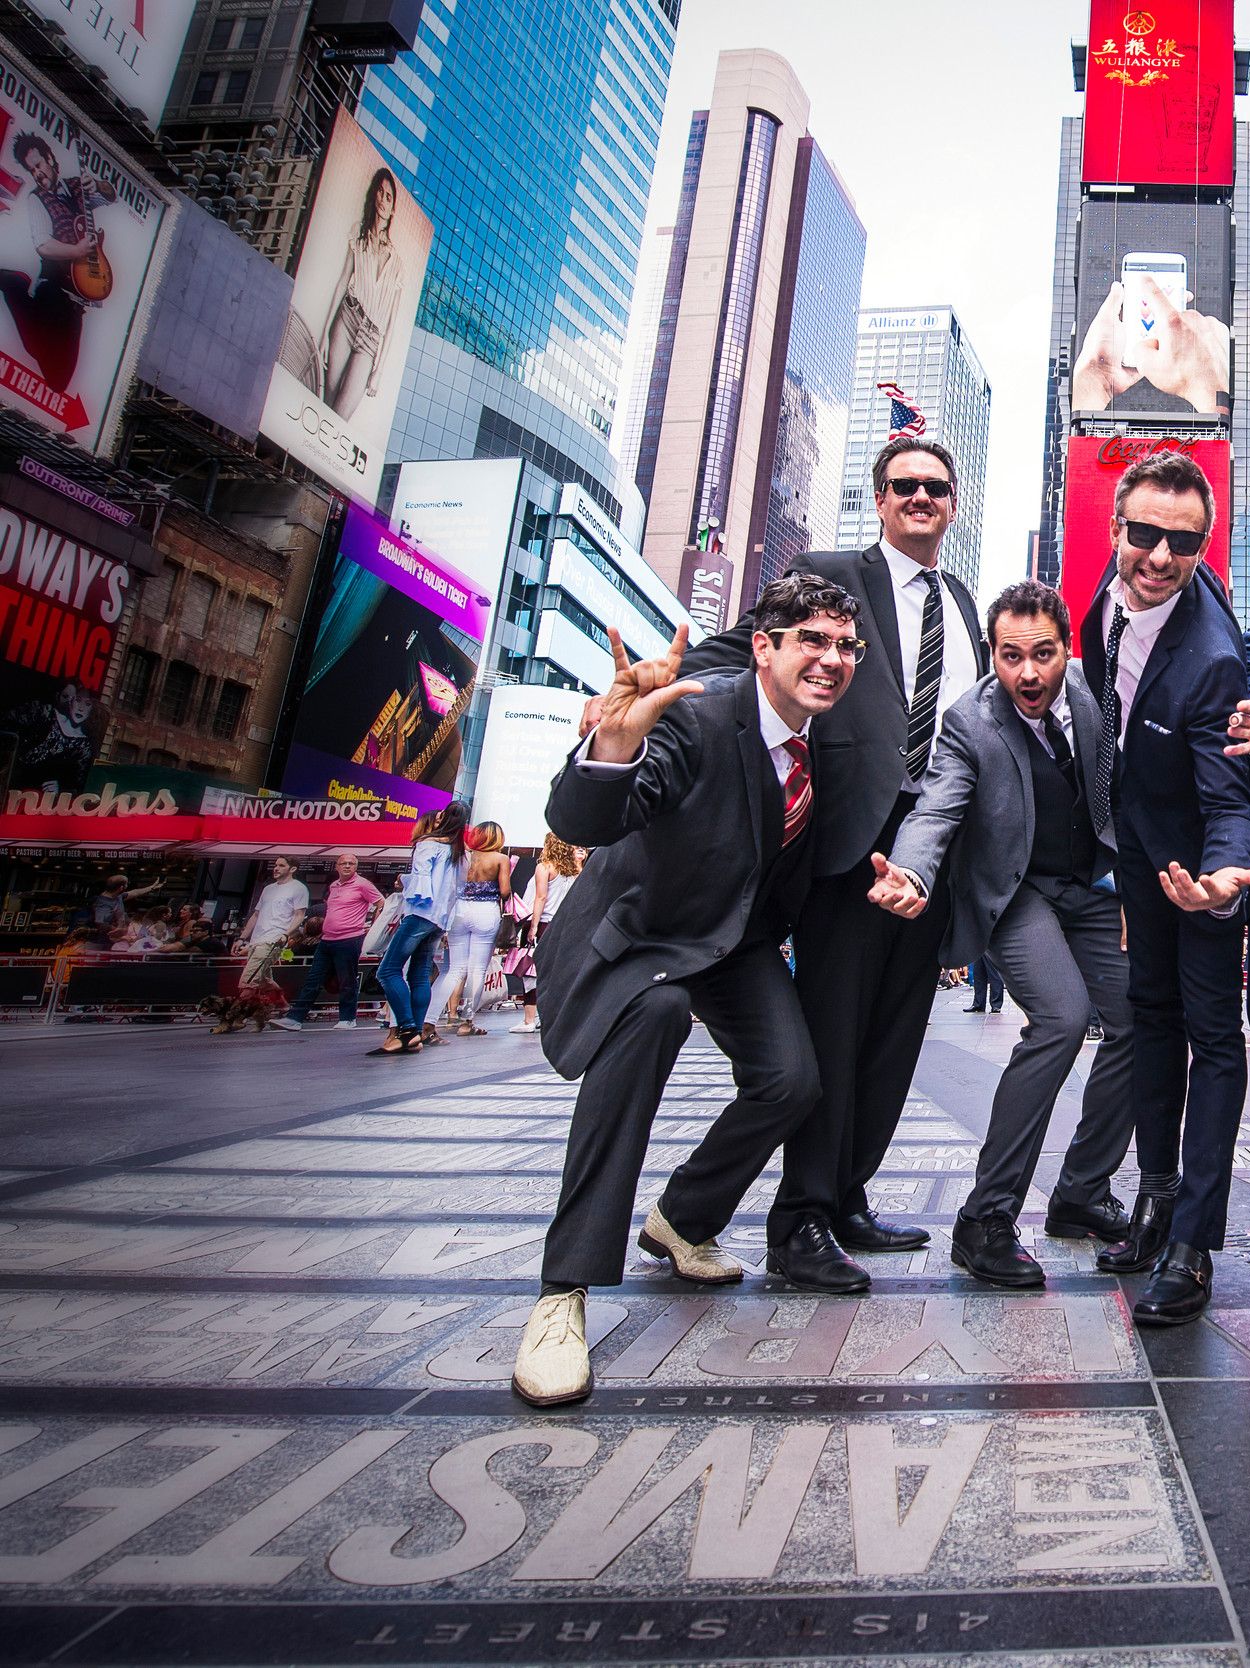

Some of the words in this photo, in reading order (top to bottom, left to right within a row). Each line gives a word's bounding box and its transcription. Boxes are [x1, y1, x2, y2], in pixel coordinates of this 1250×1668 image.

[1095, 58, 1181, 67] WULIANGYE
[868, 317, 917, 328] Allianz
[10, 364, 68, 416] THEATRE
[405, 501, 441, 509] Economic
[577, 498, 606, 539] Economic
[606, 532, 622, 557] News
[378, 537, 424, 580] BROADWAY'S
[505, 711, 545, 720] Economic
[549, 714, 571, 724] News
[8, 782, 178, 817] nuchas
[243, 800, 283, 819] NYC
[16, 848, 42, 857] PASTRIES
[1014, 1422, 1169, 1572] NEW
[355, 1618, 729, 1647] STREET
